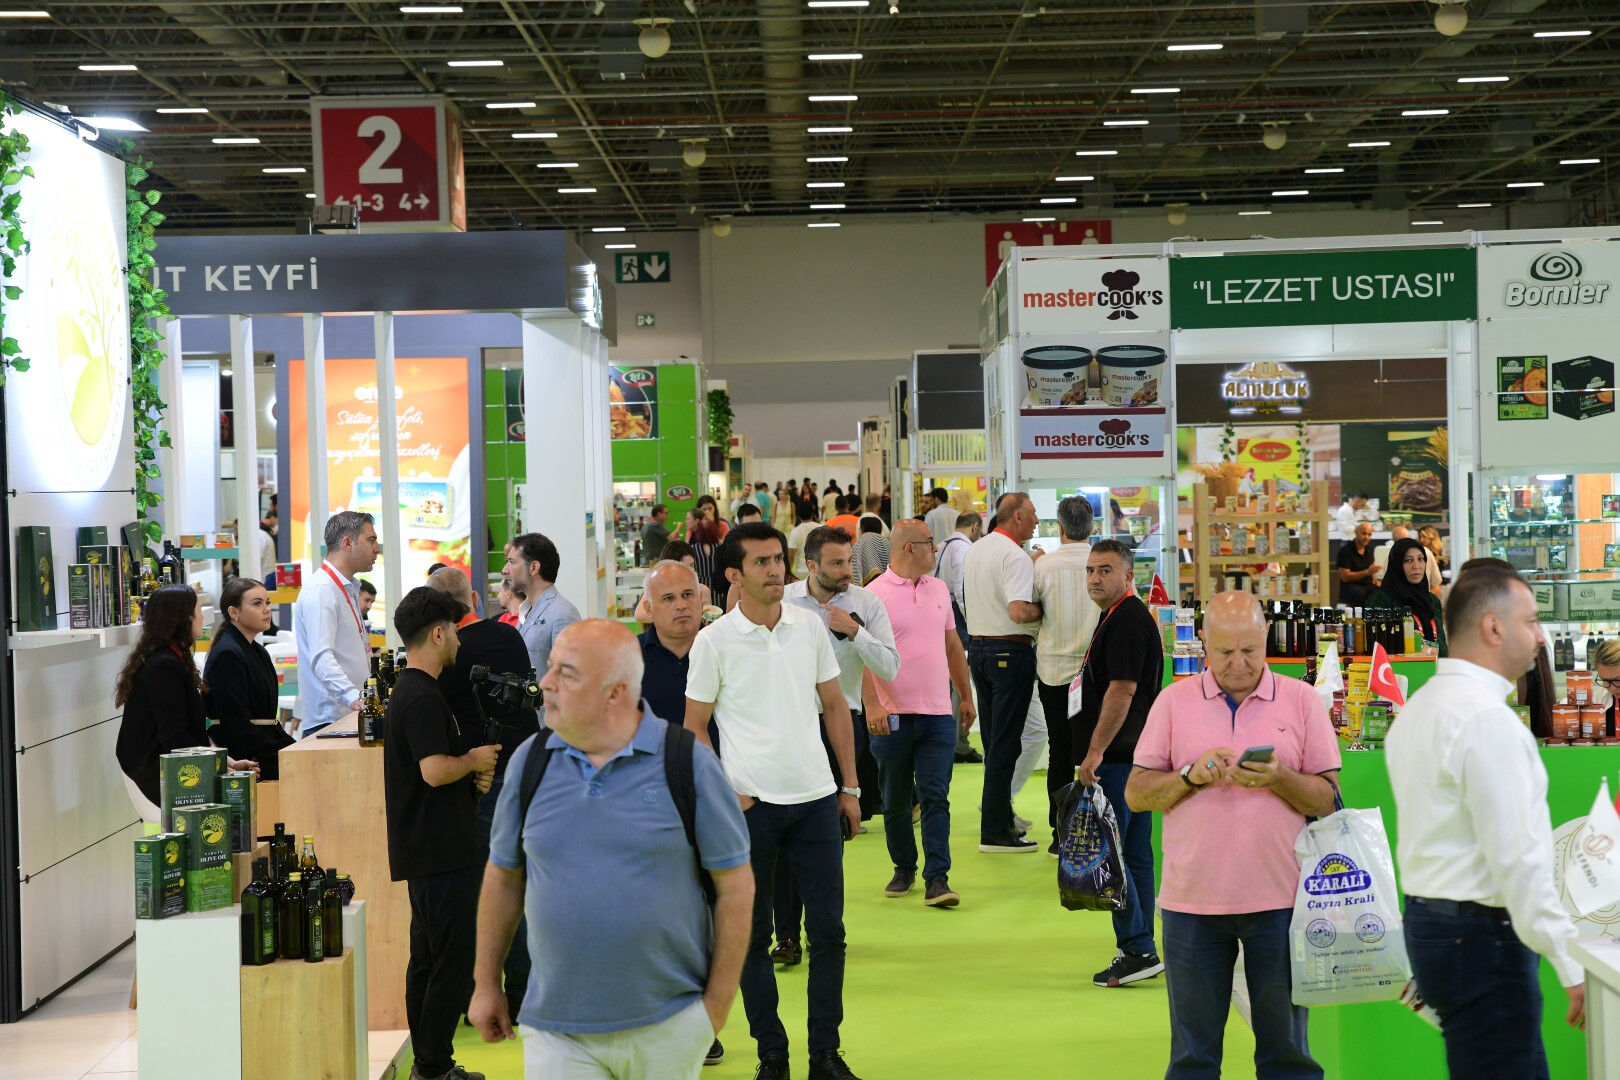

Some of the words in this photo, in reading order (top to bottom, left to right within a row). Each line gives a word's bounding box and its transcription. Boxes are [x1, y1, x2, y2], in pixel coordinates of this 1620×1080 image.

[357, 115, 403, 184] 2
[399, 193, 412, 211] 4
[204, 257, 318, 292] KEYFİ
[1332, 272, 1454, 301] USTASI"
[1505, 278, 1609, 307] Bornier
[1308, 873, 1366, 892] KARALİ
[1307, 900, 1341, 911] Çayın
